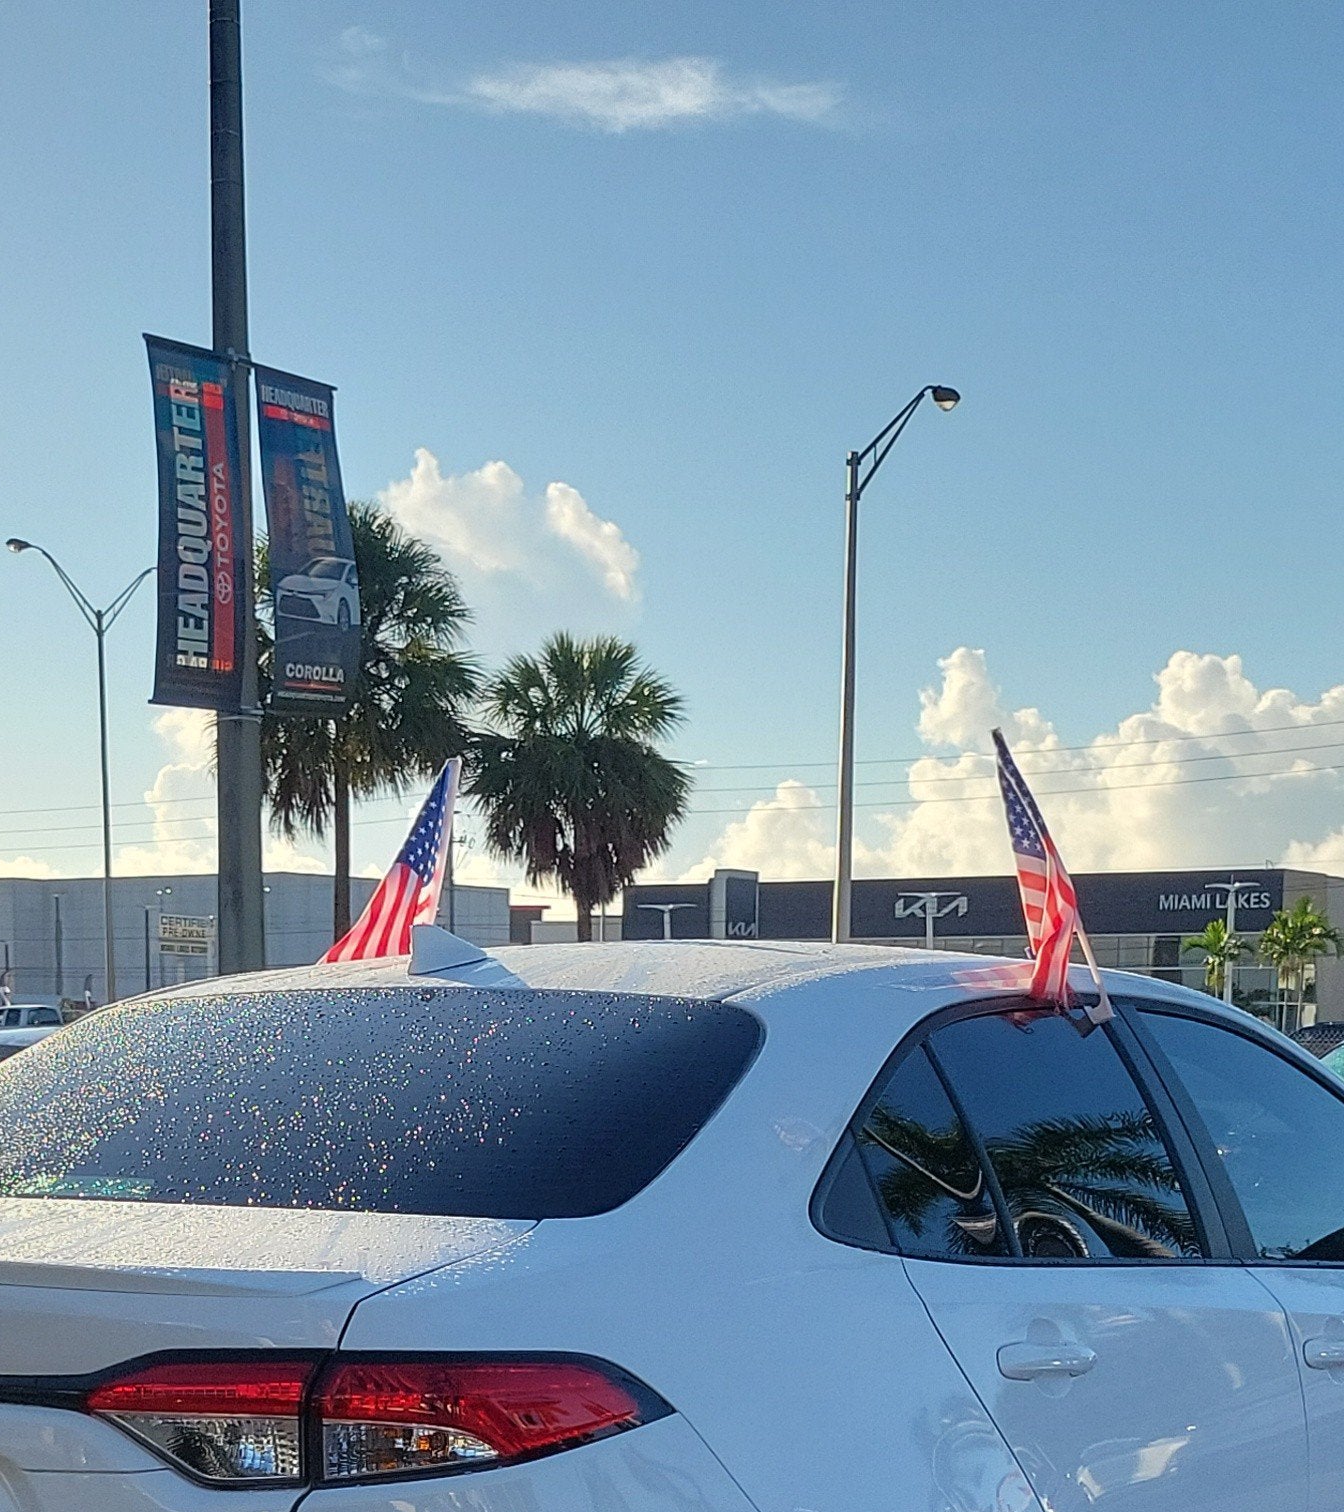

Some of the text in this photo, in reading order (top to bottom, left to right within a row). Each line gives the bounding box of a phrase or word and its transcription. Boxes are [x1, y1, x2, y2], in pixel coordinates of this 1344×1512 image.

[170, 378, 209, 668] HEADQUARTER
[211, 462, 233, 566] TOYOTA
[285, 663, 345, 683] COROLLA
[1159, 892, 1271, 911] MIAMI LKES
[161, 915, 213, 928] CERTIFIE
[162, 926, 208, 938] PRE-OWNE
